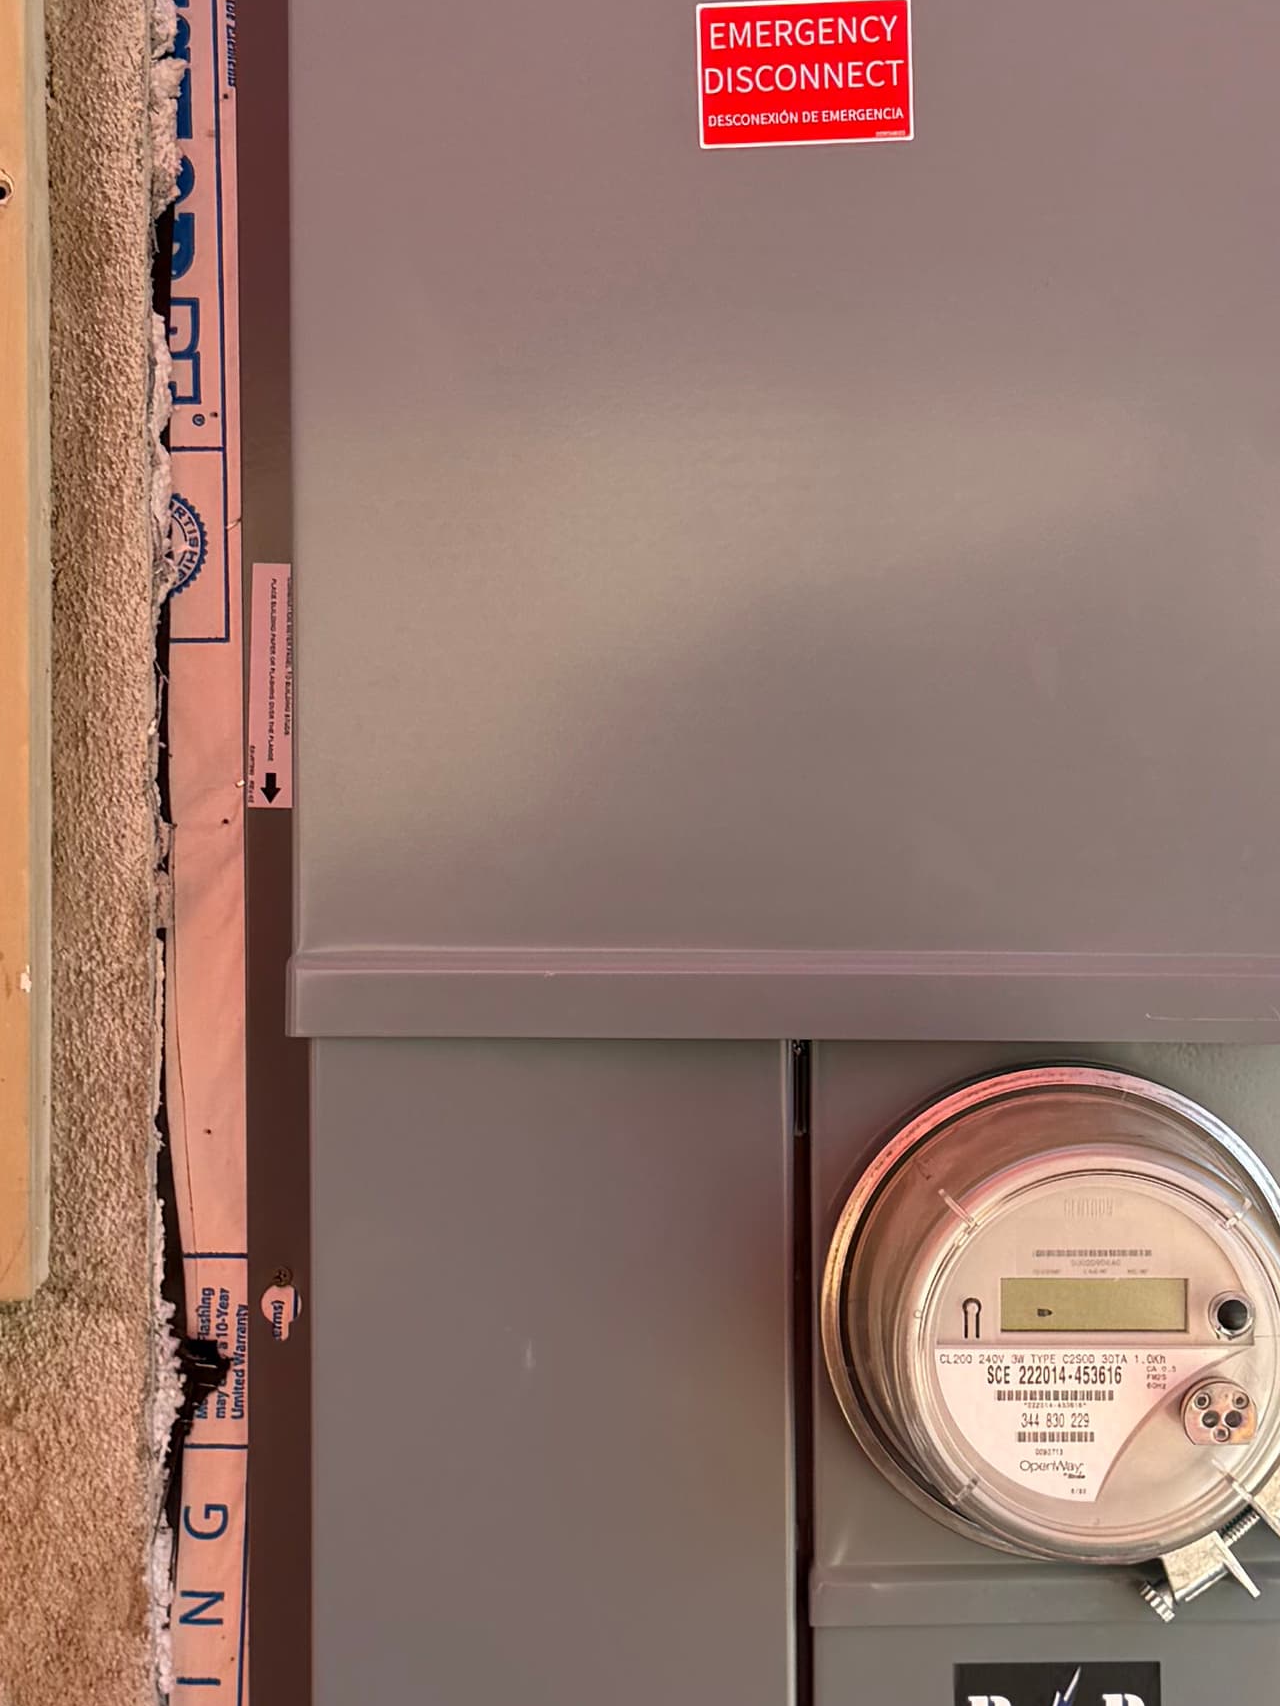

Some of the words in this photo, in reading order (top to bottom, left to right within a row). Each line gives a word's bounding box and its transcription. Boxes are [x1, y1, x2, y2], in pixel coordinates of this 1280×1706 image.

[709, 15, 898, 50] EMERGENCY
[704, 59, 905, 95] DISCONNECT
[707, 109, 799, 127] DESCONEXIÓN
[802, 110, 818, 123] DE
[821, 107, 904, 123] EMERGENCIA
[269, 656, 276, 666] OR
[268, 668, 276, 699] FLASHING
[214, 1287, 230, 1338] 10-Year
[270, 1300, 285, 1340] erms)
[939, 1354, 973, 1364] CL200
[979, 1354, 1006, 1364] 240V
[1011, 1354, 1024, 1364] 3W
[1030, 1353, 1057, 1364] TYPE
[986, 1365, 1011, 1385] SCE
[215, 1391, 230, 1419] may
[230, 1369, 246, 1420] Limited
[1020, 1413, 1040, 1428] 344
[1046, 1413, 1065, 1428] 830
[1071, 1413, 1090, 1428] 229
